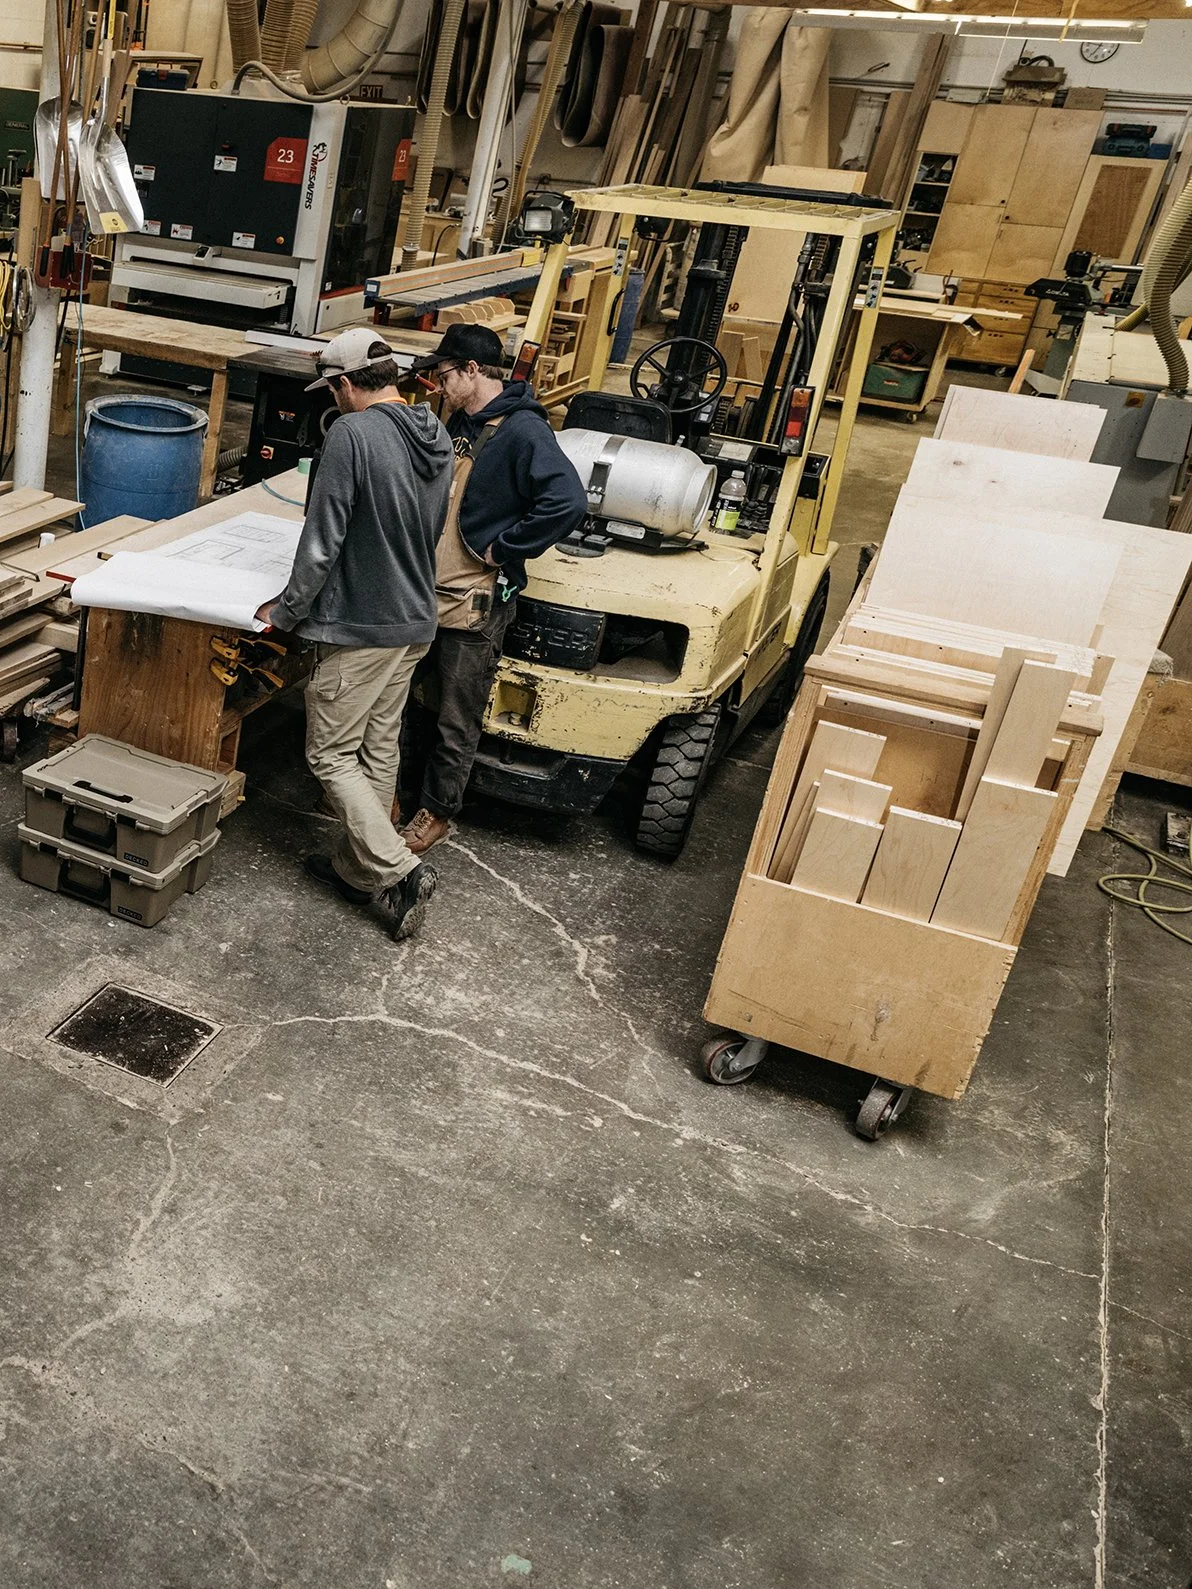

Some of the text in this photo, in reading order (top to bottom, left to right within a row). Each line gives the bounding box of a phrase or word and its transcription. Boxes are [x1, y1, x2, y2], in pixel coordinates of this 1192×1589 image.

[360, 86, 382, 98] EXIT
[277, 148, 294, 164] 23
[398, 149, 407, 163] 23
[305, 153, 319, 210] TIMESAVERS
[510, 622, 596, 651] STER
[124, 854, 148, 866] DECKED
[118, 907, 143, 920] DECKED
